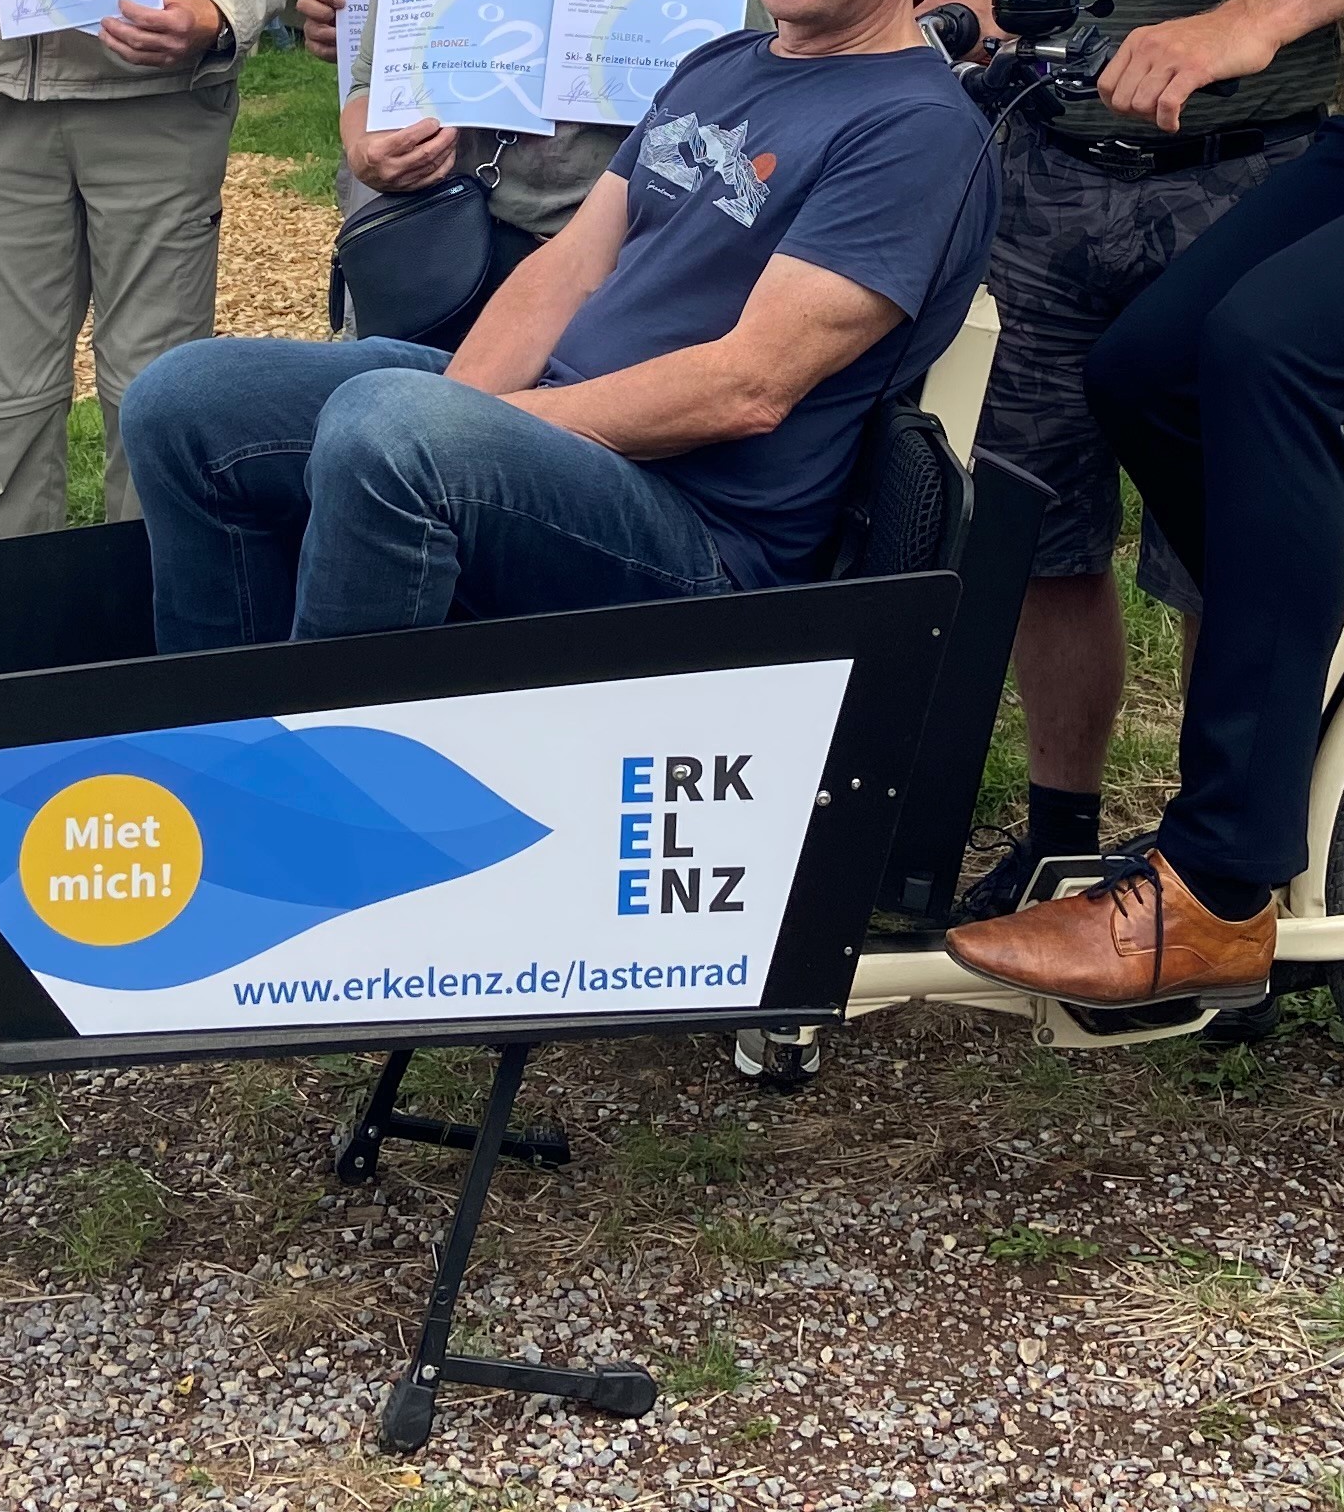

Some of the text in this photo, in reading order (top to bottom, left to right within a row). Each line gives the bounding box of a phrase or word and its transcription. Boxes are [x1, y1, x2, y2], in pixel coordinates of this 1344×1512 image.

[348, 3, 370, 13] STAD
[430, 38, 470, 49] BRONZE
[610, 31, 644, 43] SILBER
[383, 59, 532, 75] SFC Ski- & Freizeitclub Erkelenz
[565, 50, 680, 69] Ski- & Freizeitclub Erkel
[622, 754, 755, 804] ERK
[65, 812, 161, 851] Miet
[619, 813, 694, 860] EL
[49, 863, 172, 902] mich!
[617, 866, 746, 916] ENZ
[233, 955, 749, 1006] www.erkelenz.de/lastenrad
